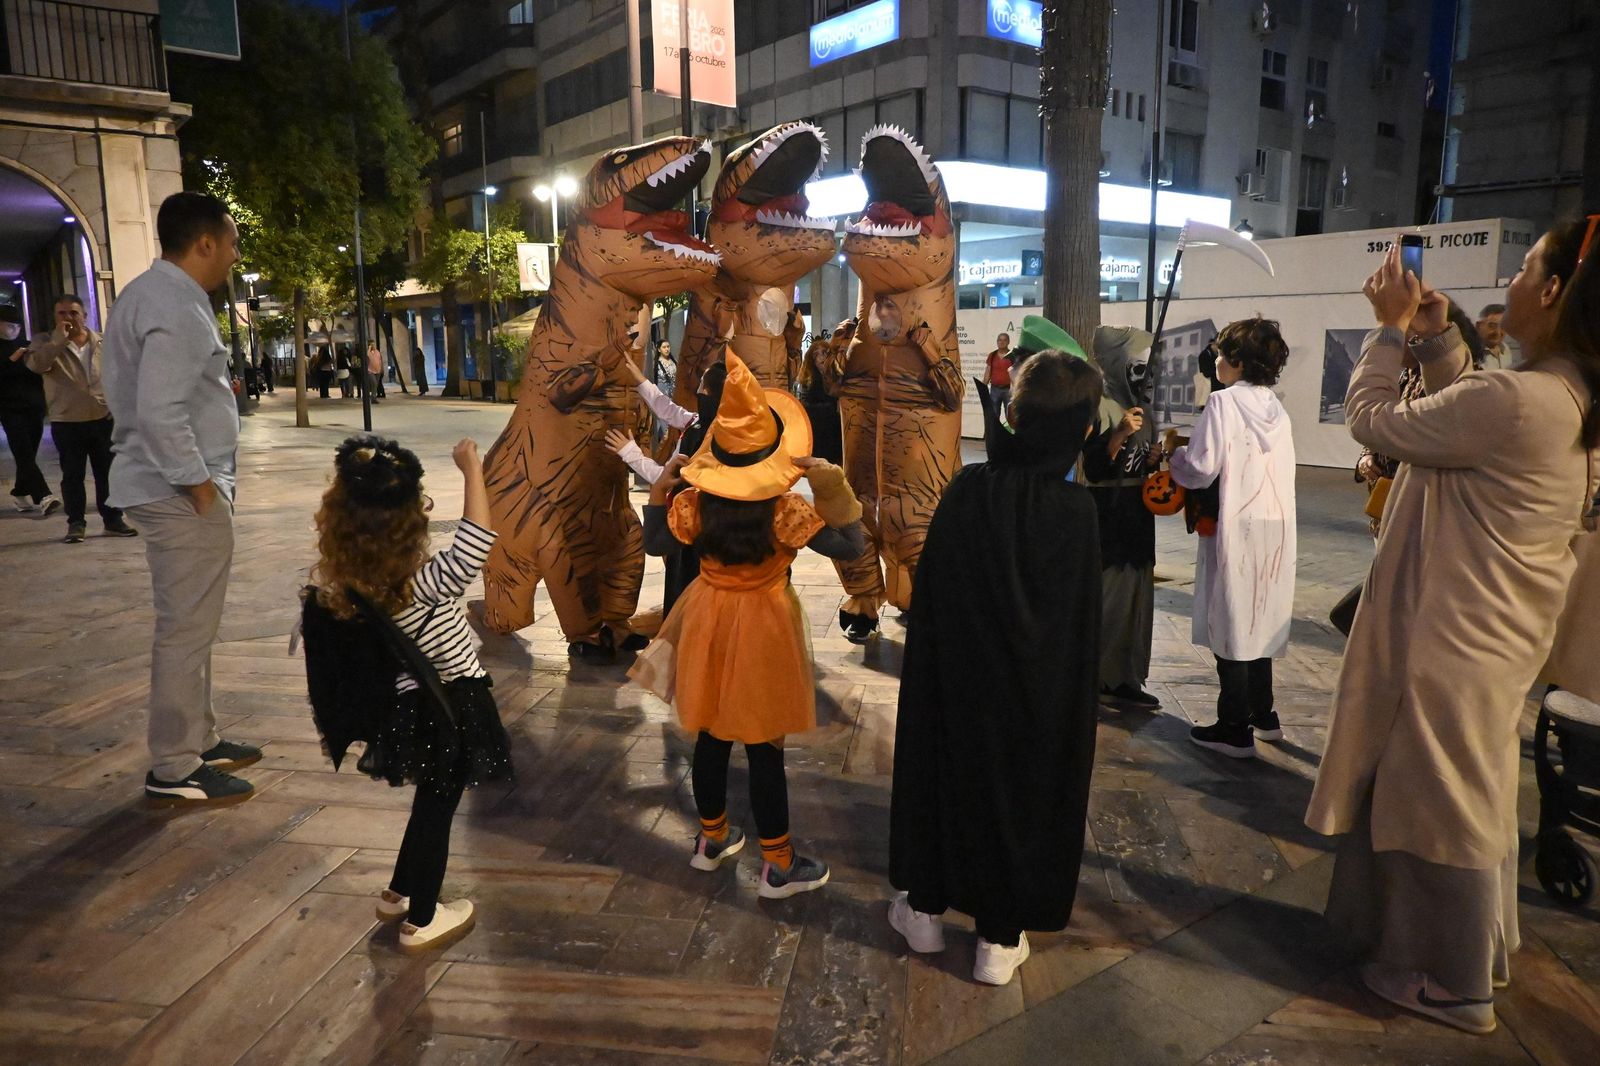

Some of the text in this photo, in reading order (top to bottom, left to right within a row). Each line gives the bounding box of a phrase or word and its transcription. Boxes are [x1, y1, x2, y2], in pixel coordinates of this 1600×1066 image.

[993, 3, 1043, 31] mediol
[710, 26, 726, 36] 2025
[814, 13, 895, 57] mediolanum
[689, 29, 726, 57] BRO
[664, 46, 674, 57] 17
[695, 55, 726, 68] octubre
[1440, 231, 1489, 248] PICOTE
[969, 261, 1018, 280] cajamar
[1030, 257, 1040, 269] 24
[1100, 258, 1141, 276] cajamar
